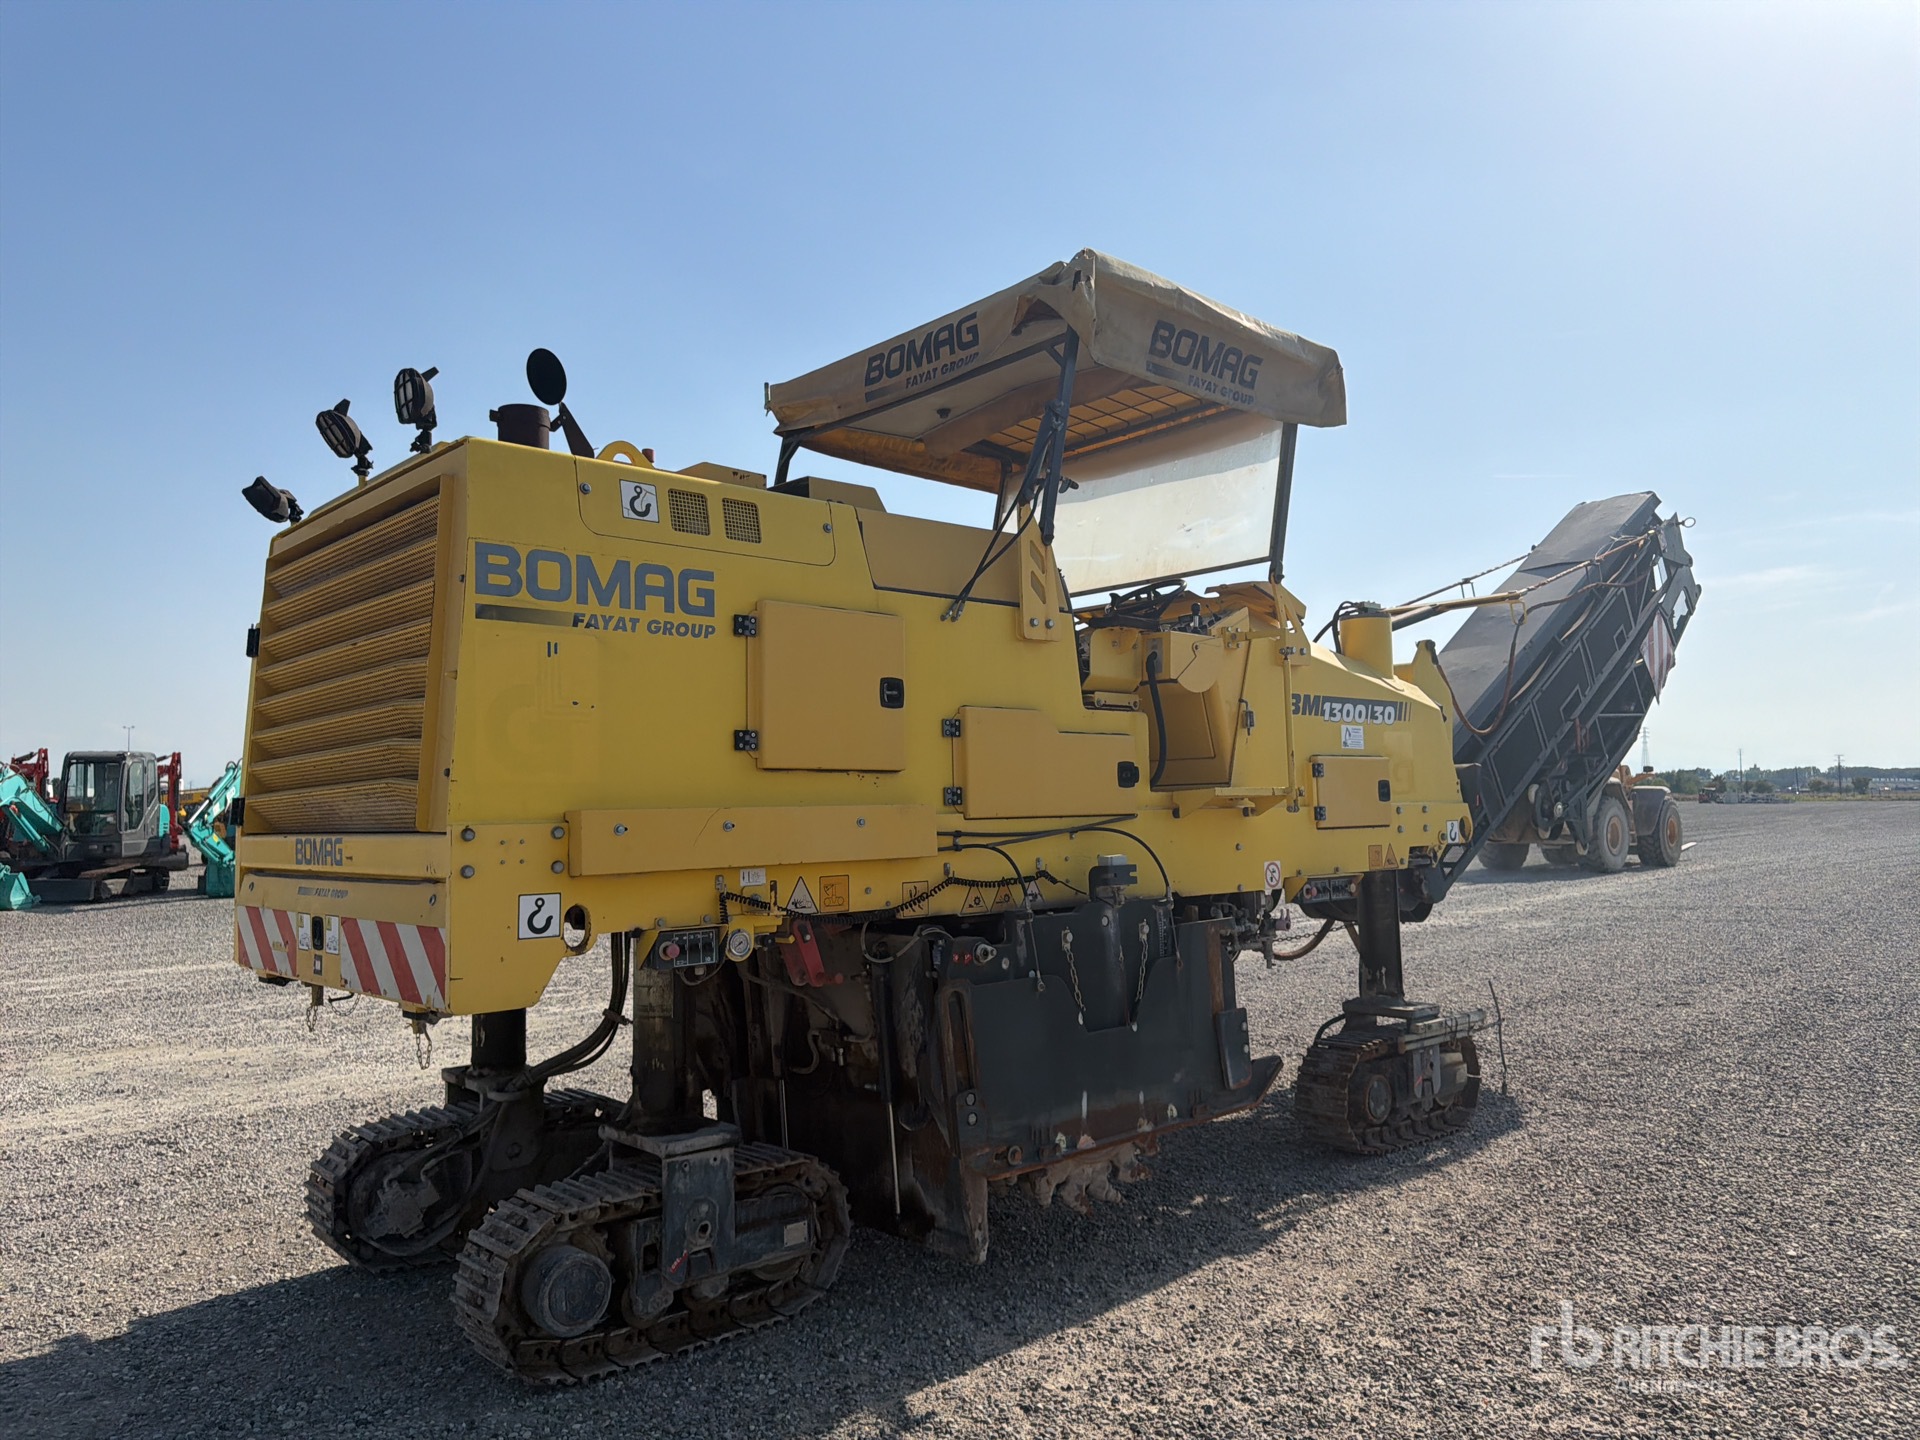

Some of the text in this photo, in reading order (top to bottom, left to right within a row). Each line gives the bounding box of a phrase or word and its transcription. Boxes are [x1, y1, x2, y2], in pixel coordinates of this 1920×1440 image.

[864, 311, 980, 387] BOMAG
[1148, 319, 1264, 390] BOMAG
[905, 352, 980, 389] FAYAT GROUP
[1188, 374, 1220, 395] FAYAT
[475, 541, 716, 618] BOMAG
[571, 612, 717, 640] FAYAT GROUP
[295, 837, 344, 867] BOMAG
